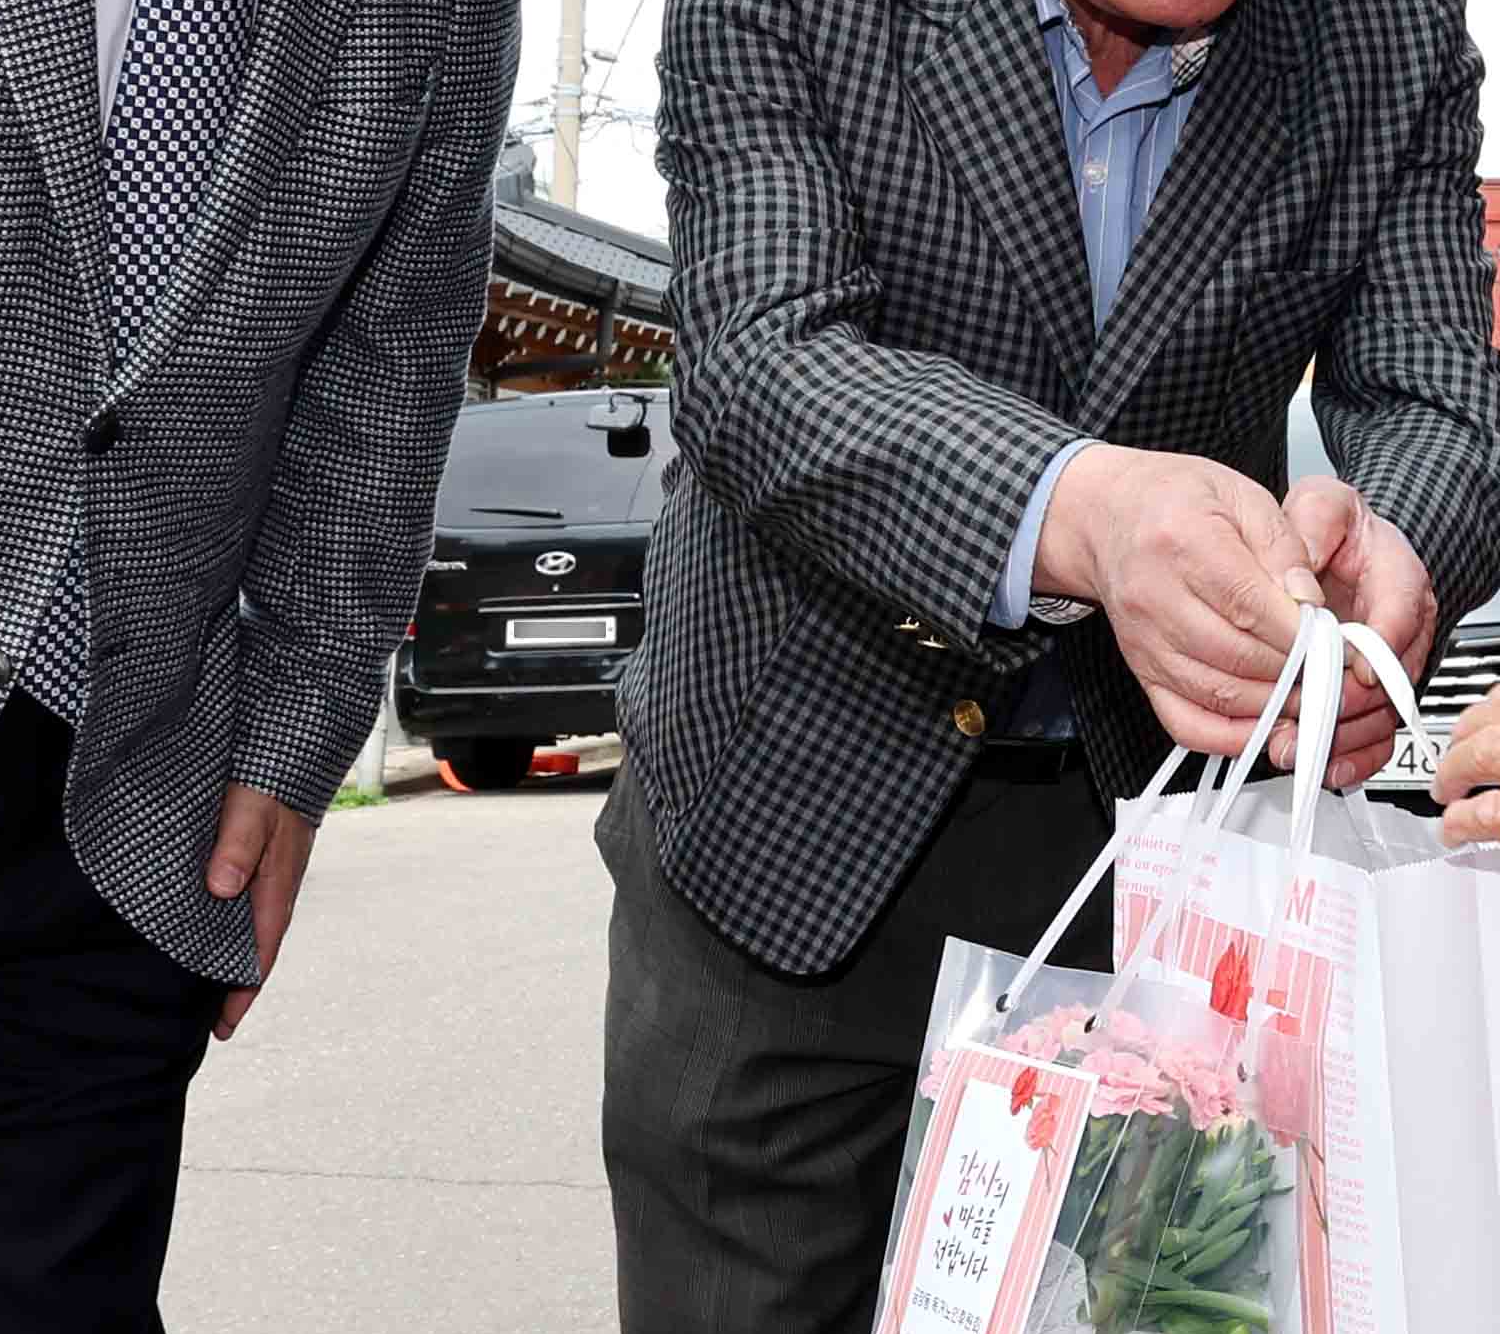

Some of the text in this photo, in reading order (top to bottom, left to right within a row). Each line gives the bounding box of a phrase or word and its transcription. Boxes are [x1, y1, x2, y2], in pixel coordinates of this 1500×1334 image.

[957, 1150, 1011, 1209] 감사의
[958, 1205, 996, 1245] 마음을
[934, 1236, 989, 1283] 전합니다
